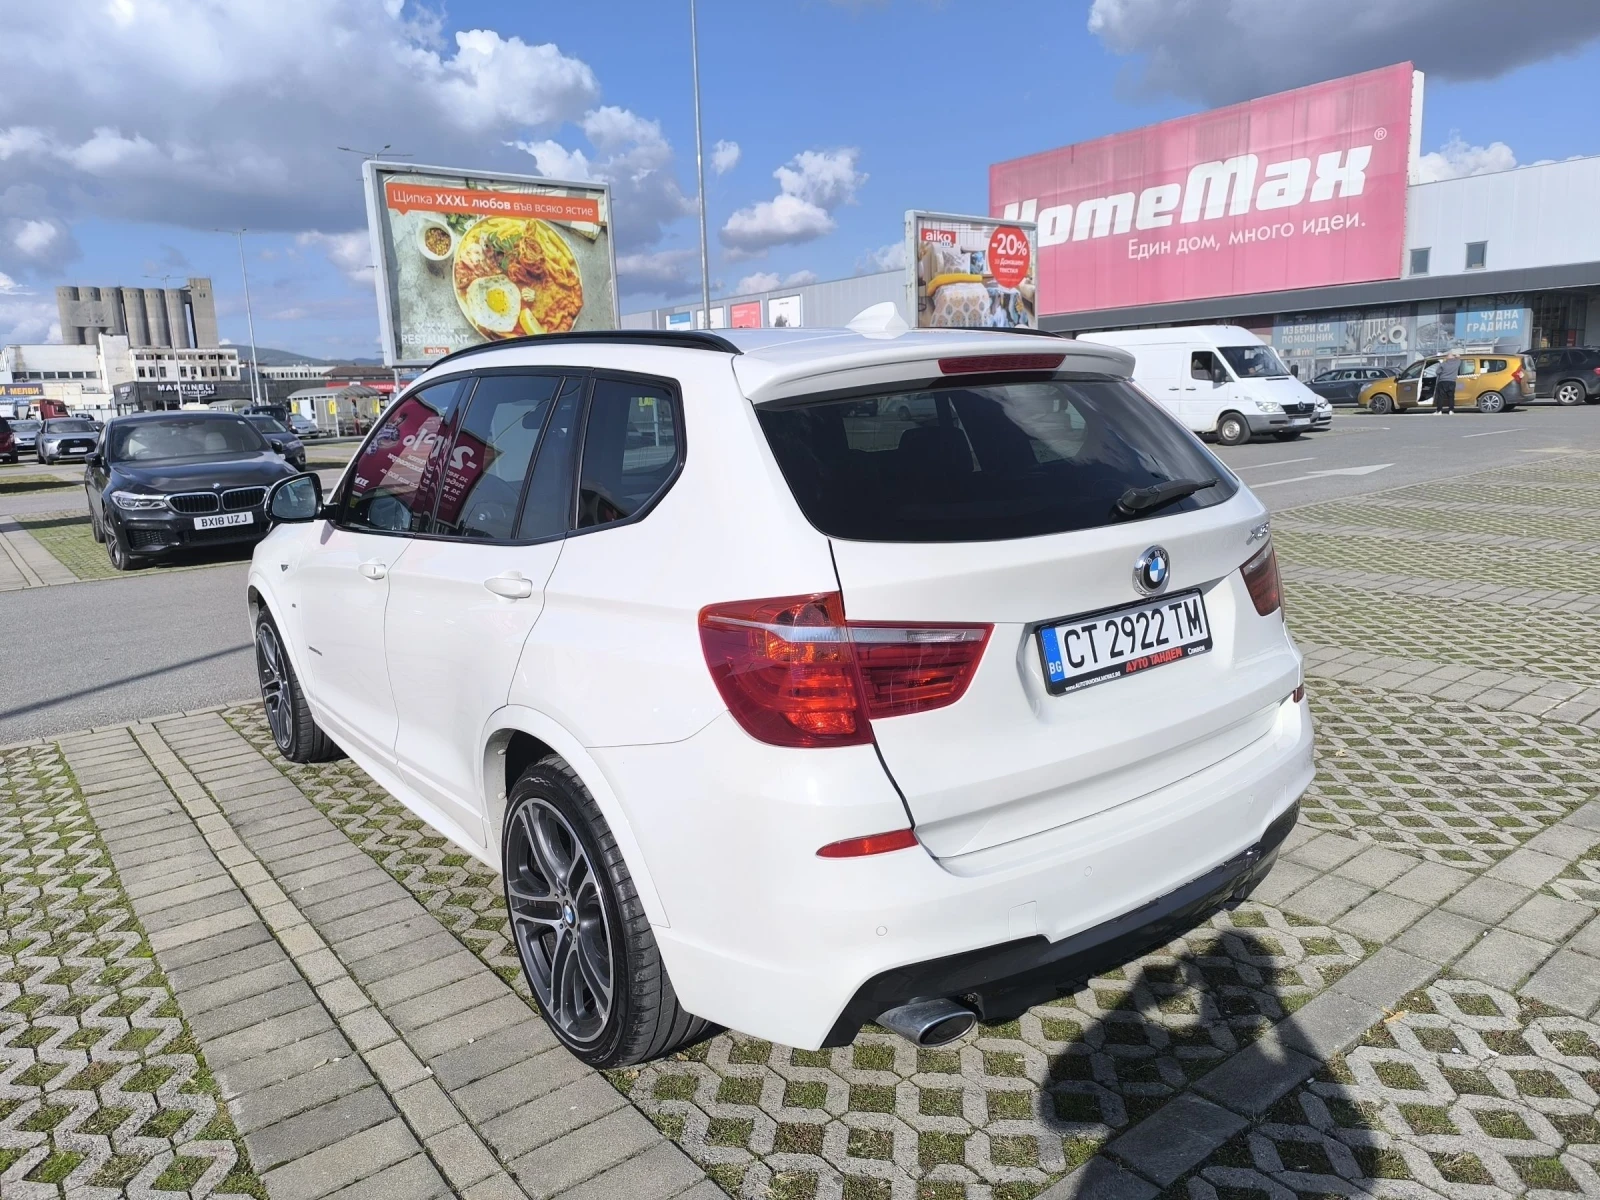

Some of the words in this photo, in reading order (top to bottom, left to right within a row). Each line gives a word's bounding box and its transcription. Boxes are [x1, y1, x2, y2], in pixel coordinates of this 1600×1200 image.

[393, 190, 433, 205] Щипка
[435, 193, 468, 207] XXXL
[471, 198, 511, 210] любов
[514, 203, 532, 212] във
[535, 204, 563, 214] всяко
[565, 207, 593, 216] ястие
[926, 231, 951, 242] aiko
[1128, 238, 1171, 259] Един
[1175, 233, 1220, 254] дом,
[1229, 222, 1294, 243] много
[1302, 213, 1366, 234] идеи.
[991, 233, 1027, 256] -20%
[1480, 309, 1519, 321] ЧУДНА
[1283, 324, 1316, 335] ИЗБЕРИ
[1318, 324, 1330, 332] СИ
[1467, 320, 1518, 333] ГРАДИНА
[401, 334, 468, 345] RESTAURANT
[1281, 333, 1334, 344] ПОМОЩНИК
[201, 515, 224, 527] BX18
[226, 513, 248, 525] UZJ
[1064, 623, 1098, 669] CT
[1105, 608, 1169, 659] 2922
[1169, 599, 1203, 640] TM
[1125, 658, 1149, 673] АУТО
[1151, 646, 1183, 665] ТАНДЕМ
[1049, 661, 1063, 674] BG
